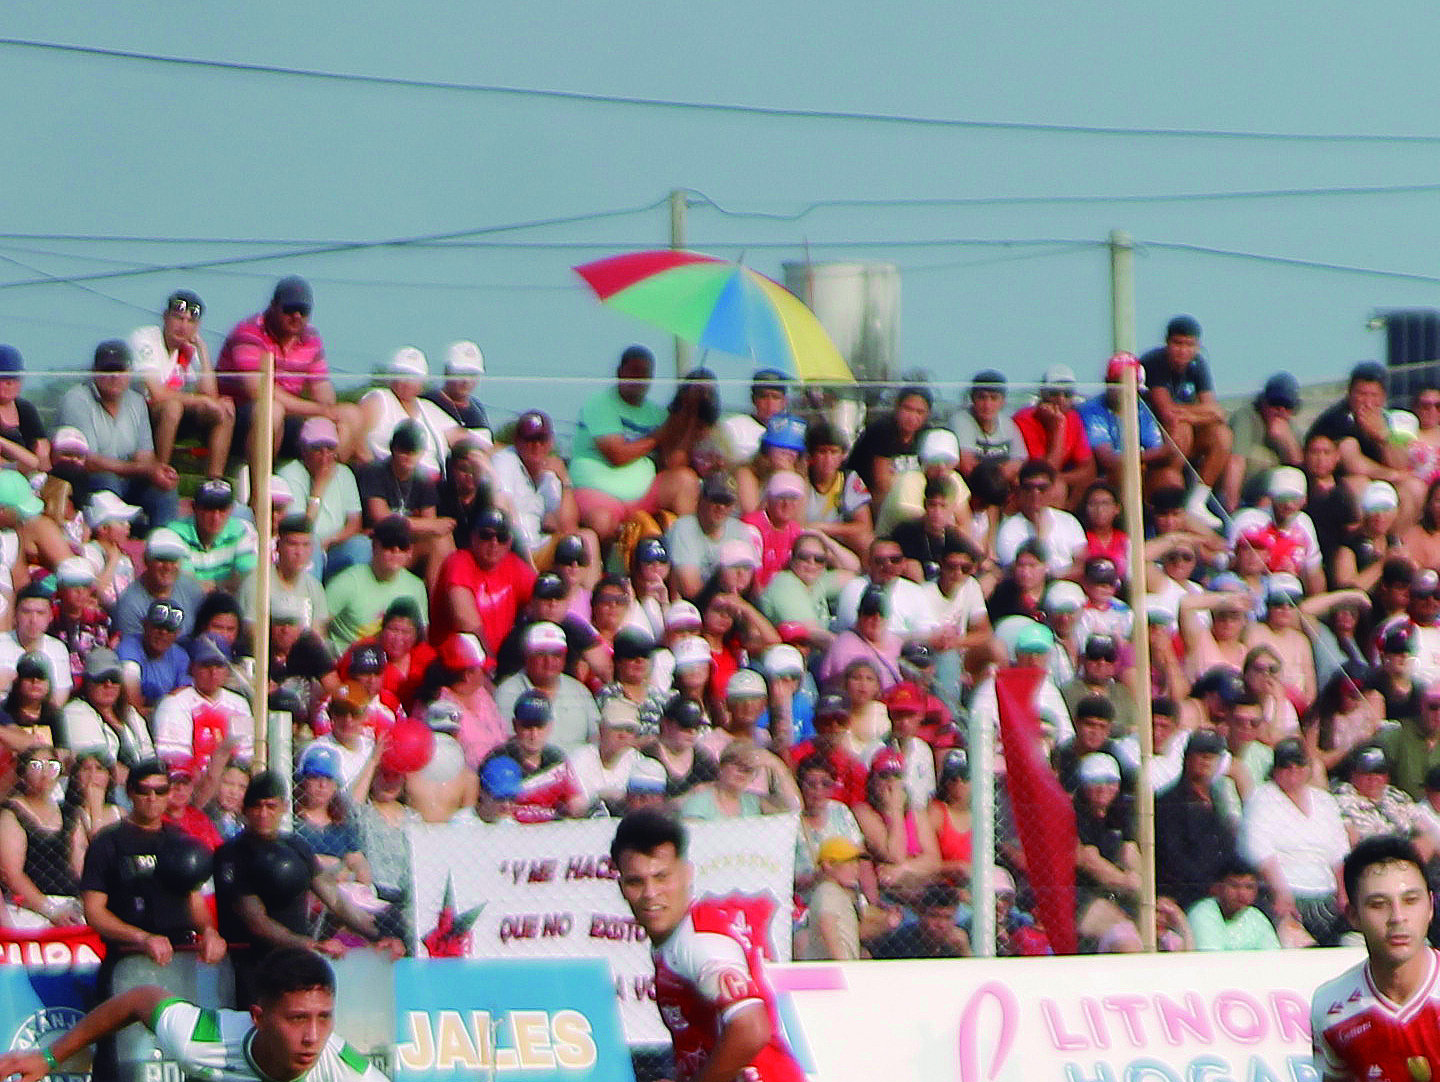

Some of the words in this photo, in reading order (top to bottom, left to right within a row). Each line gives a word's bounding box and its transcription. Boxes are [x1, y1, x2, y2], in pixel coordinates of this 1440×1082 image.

[499, 913, 541, 944] QUE
[543, 912, 572, 937] NO
[396, 1009, 598, 1071] JALES
[1041, 988, 1314, 1051] LITNOR
